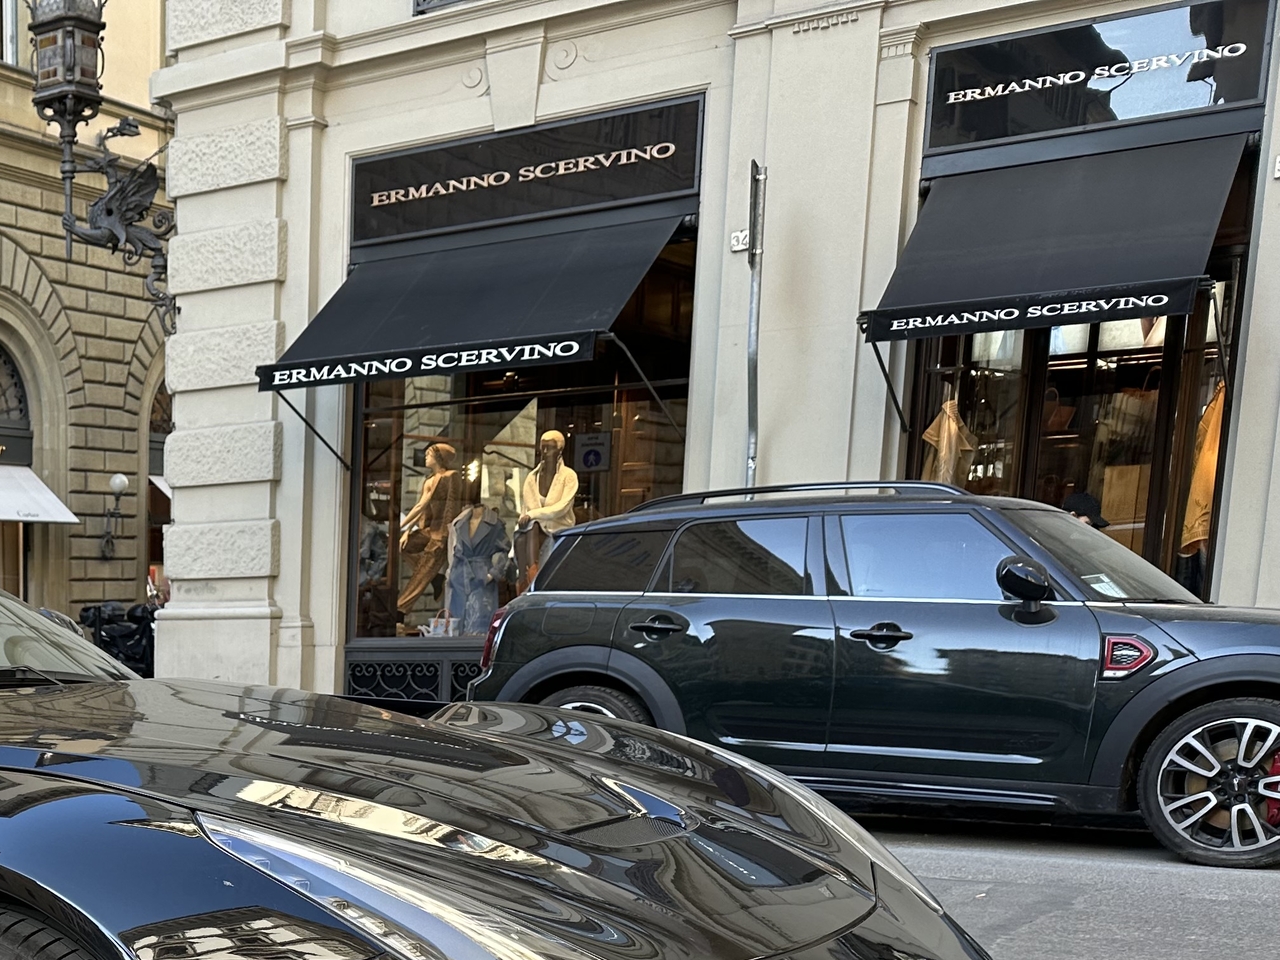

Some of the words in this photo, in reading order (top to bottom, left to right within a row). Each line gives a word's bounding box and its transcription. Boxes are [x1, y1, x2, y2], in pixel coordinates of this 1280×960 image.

[946, 71, 1086, 104] ERMANNO
[1093, 42, 1247, 79] SCERVINO
[371, 171, 511, 207] ERMANNO
[518, 142, 676, 182] SCERVINO
[890, 308, 1020, 331] ERMANNO
[1026, 294, 1169, 318] SCERVINO
[272, 357, 413, 386] ERMANNO
[420, 341, 580, 371] SCERVINO
